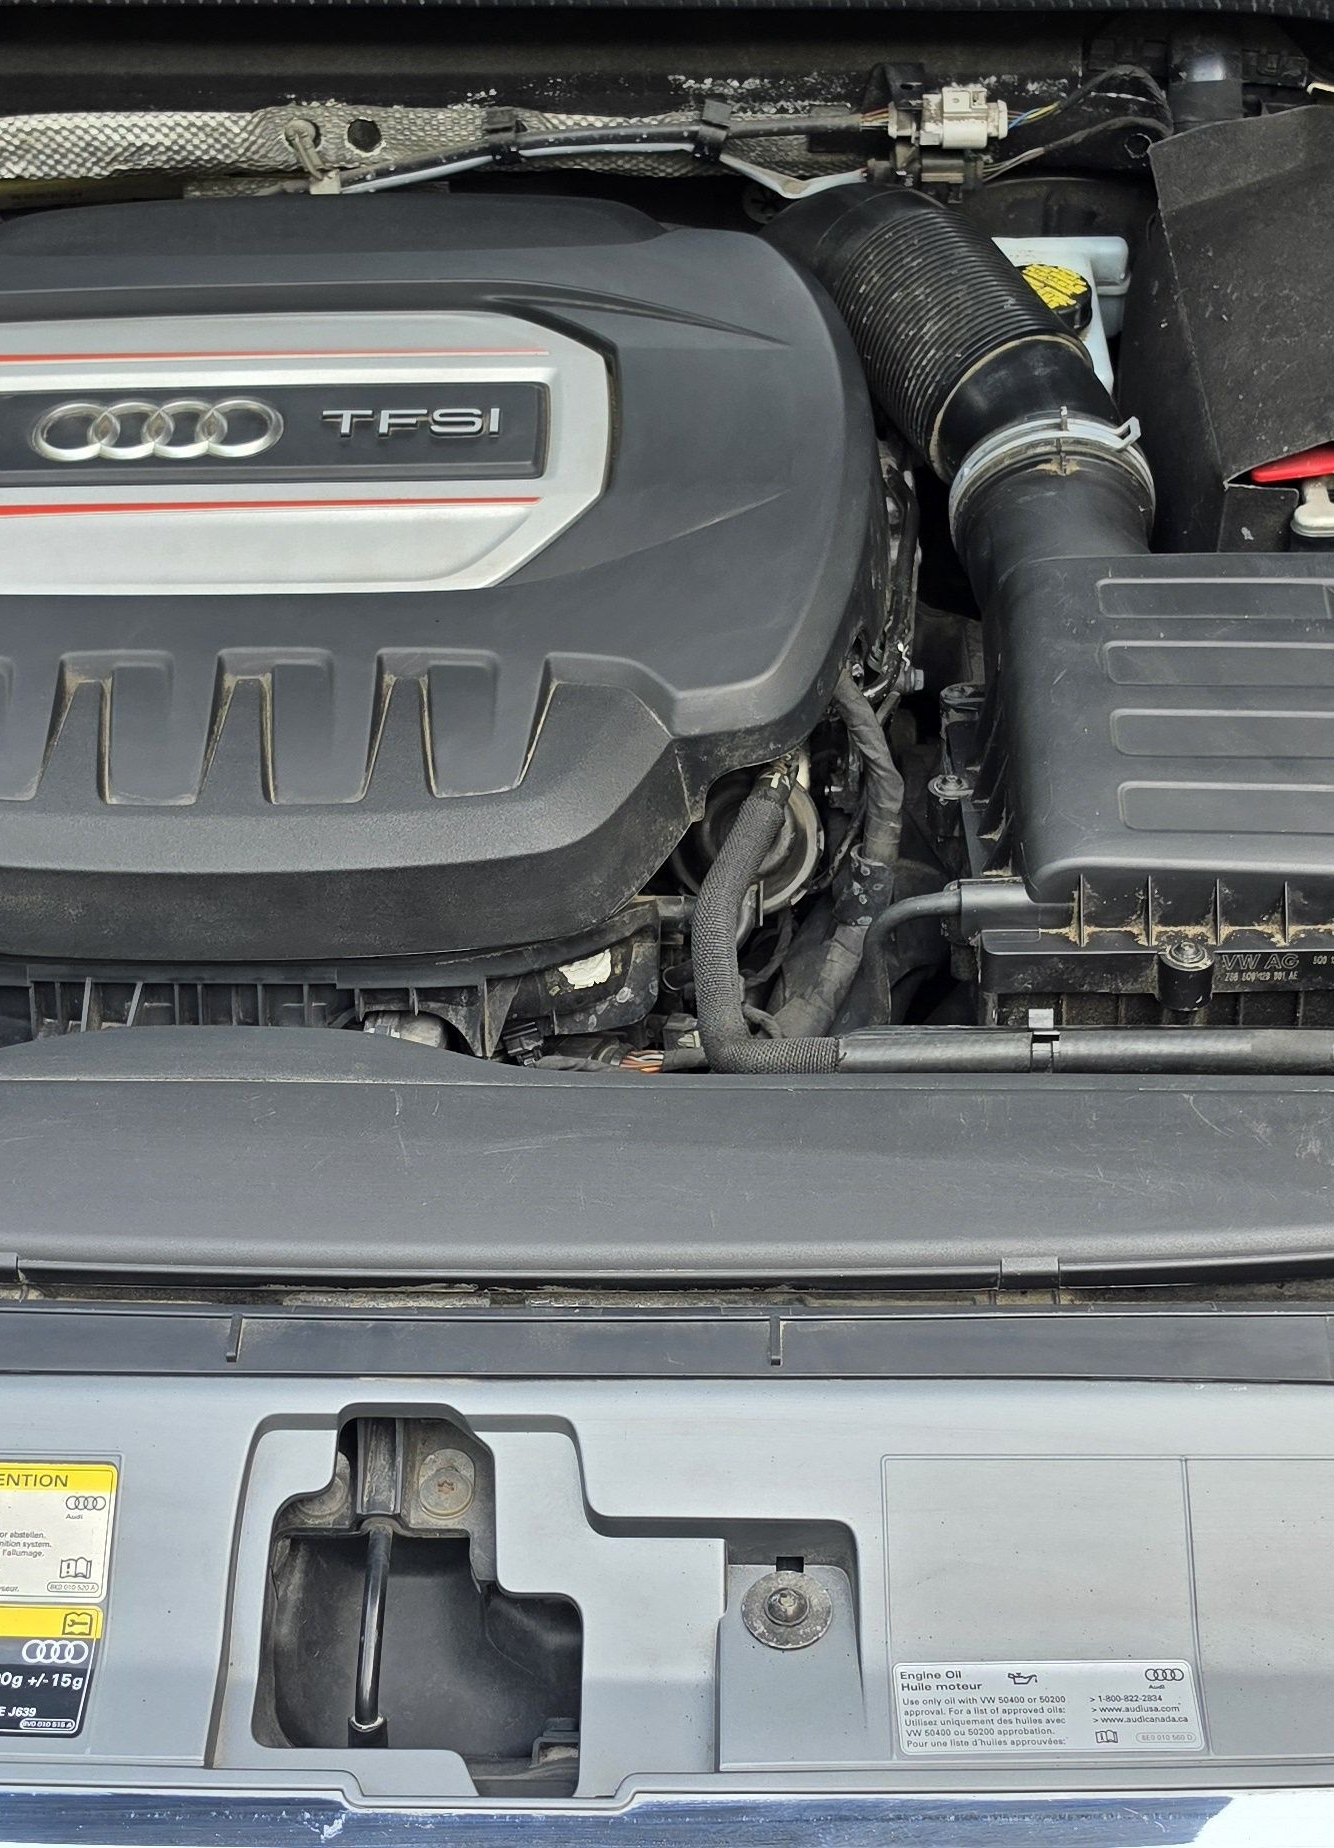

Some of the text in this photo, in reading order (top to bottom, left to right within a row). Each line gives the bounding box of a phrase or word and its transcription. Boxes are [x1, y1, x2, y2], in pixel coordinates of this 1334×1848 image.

[322, 407, 500, 438] TFSI
[1222, 953, 1261, 970] VW
[1264, 953, 1300, 969] AG
[22, 1541, 52, 1549] system.
[900, 1670, 962, 1681] Engine Oil
[901, 1683, 983, 1691] Huile moteur
[902, 1698, 920, 1706] Use
[922, 1697, 942, 1706] only
[944, 1697, 956, 1705] oil
[957, 1696, 978, 1704] with
[979, 1696, 996, 1704] VW
[998, 1696, 1025, 1704] 50400
[1039, 1695, 1066, 1703] 50200
[7, 1706, 37, 1718] J639
[904, 1708, 946, 1717] approval.
[948, 1707, 964, 1715] For
[973, 1707, 987, 1715] list
[989, 1706, 999, 1715] of
[1001, 1706, 1045, 1715] approved
[1047, 1706, 1066, 1714] oils:
[1098, 1705, 1180, 1713] www.audiusa.com
[904, 1718, 938, 1727] Utilisez
[940, 1718, 995, 1727] uniquement
[996, 1717, 1013, 1725] des
[1015, 1717, 1043, 1725] huiles
[1100, 1715, 1189, 1723] www.audicanada.ca
[906, 1729, 922, 1737] VW
[924, 1728, 951, 1737] 50400
[968, 1728, 995, 1736] 50200
[997, 1727, 1055, 1736] approbation.
[907, 1740, 928, 1748] Pour
[950, 1739, 969, 1747] liste
[1010, 1737, 1066, 1747] approuvées:
